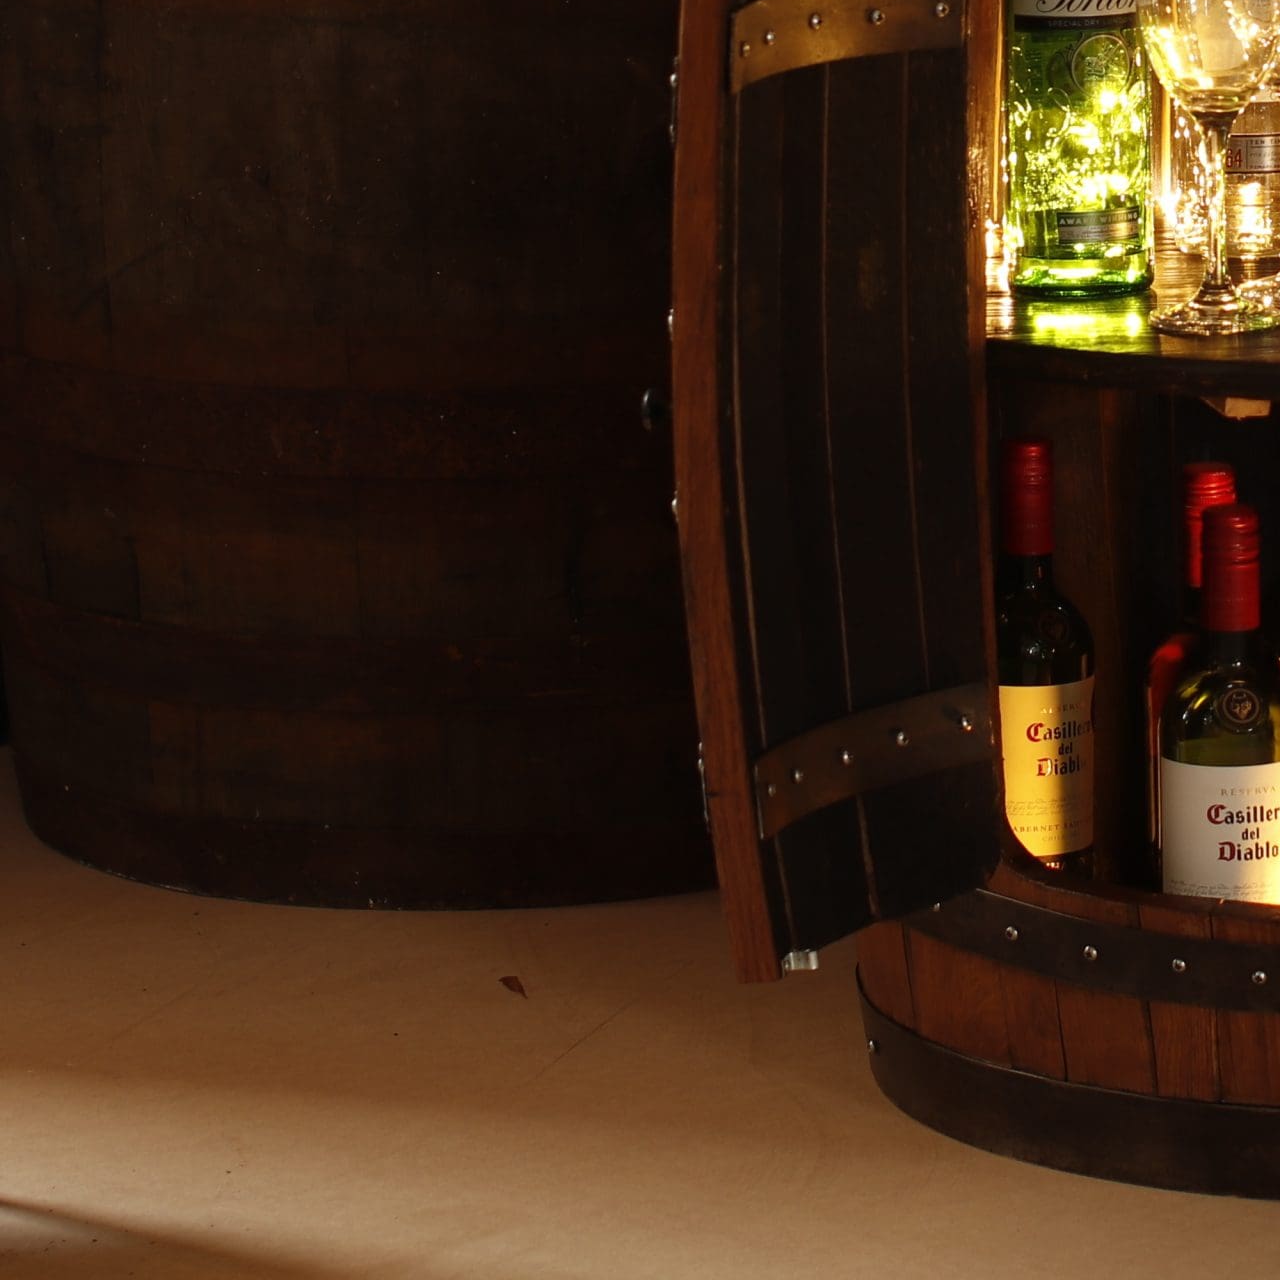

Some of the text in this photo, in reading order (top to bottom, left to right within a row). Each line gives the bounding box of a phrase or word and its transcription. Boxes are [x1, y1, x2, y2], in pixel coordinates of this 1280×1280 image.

[1026, 720, 1096, 742] Casillero
[1058, 742, 1073, 756] del
[1013, 824, 1060, 832] ABERNET
[1241, 827, 1260, 841] del
[1218, 841, 1279, 861] Diablo
